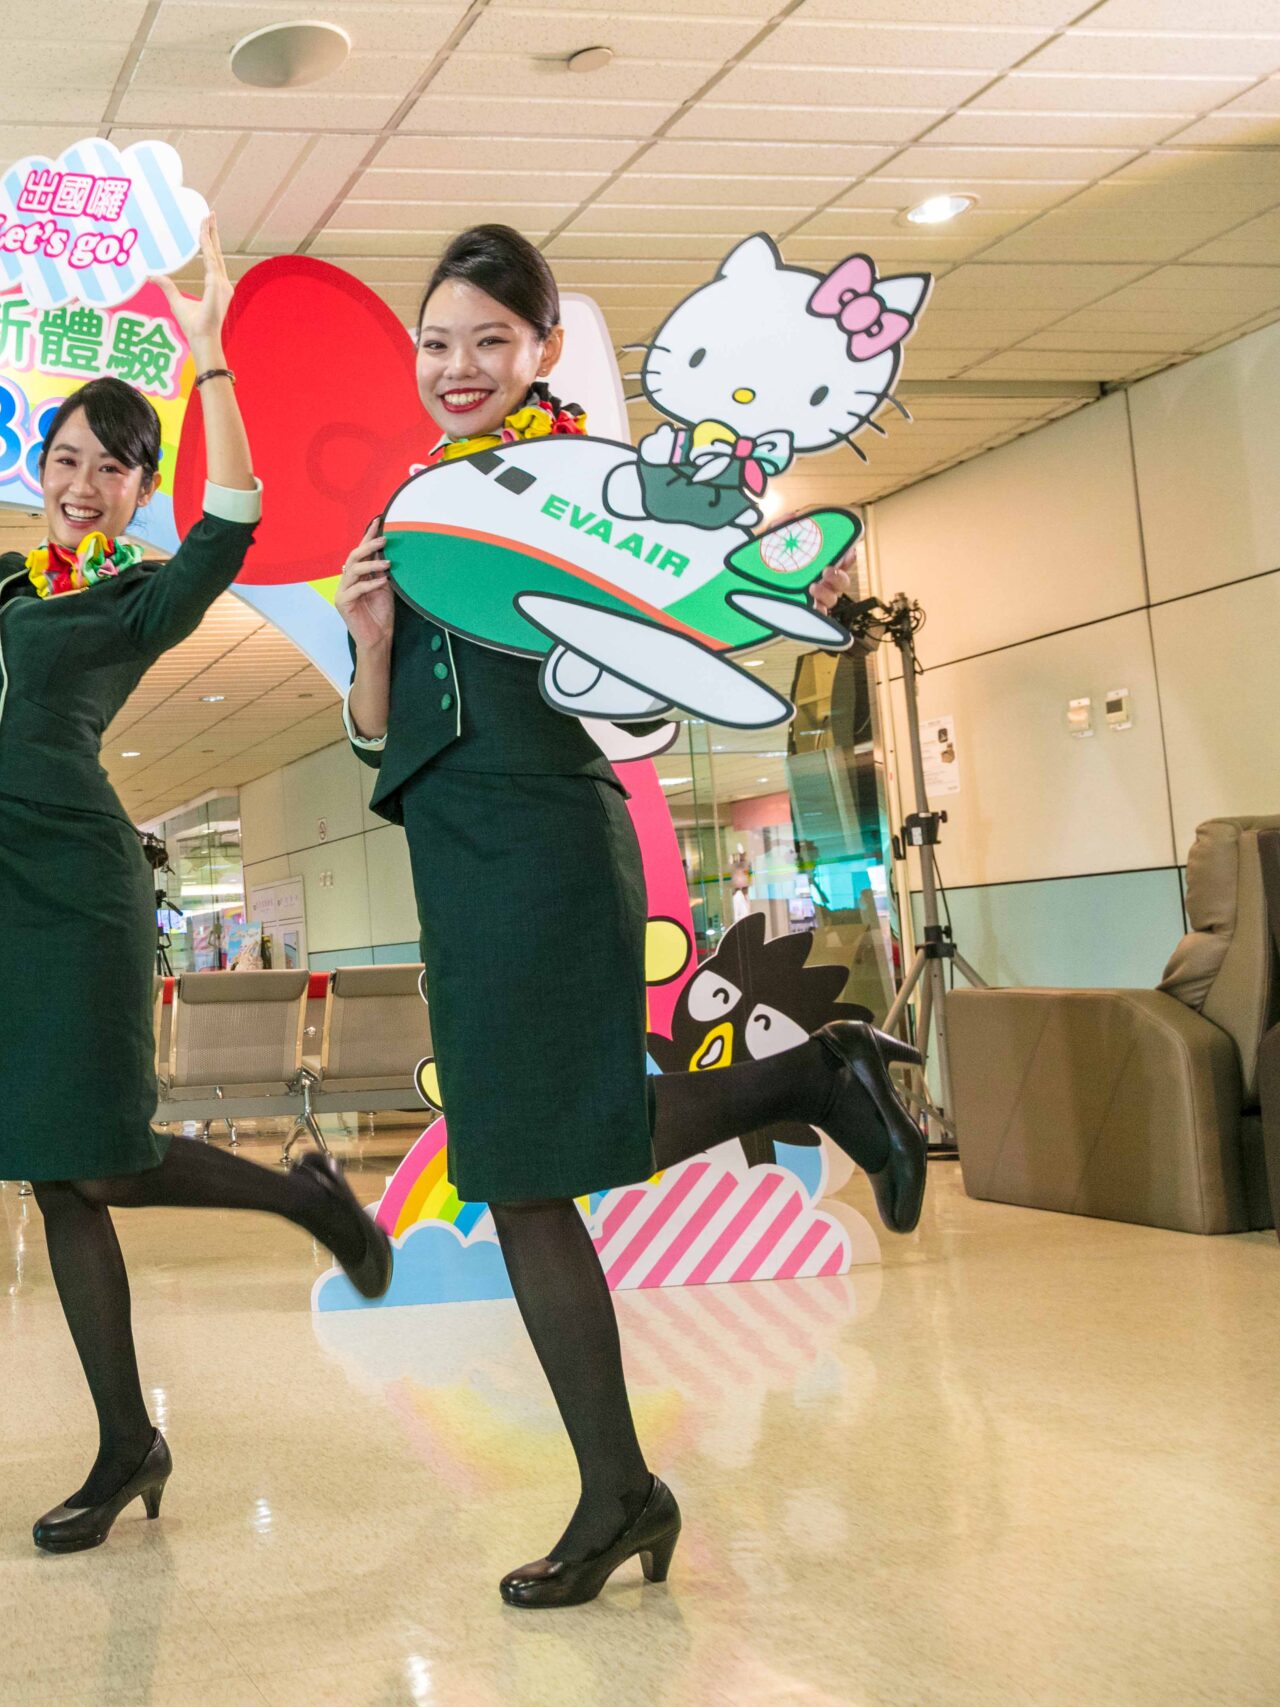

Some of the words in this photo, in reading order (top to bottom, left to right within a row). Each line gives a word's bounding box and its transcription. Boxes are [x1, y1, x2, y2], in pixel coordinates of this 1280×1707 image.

[18, 168, 131, 221] 出國囉
[68, 228, 138, 269] go!
[540, 493, 613, 544] EVA
[613, 532, 690, 578] AIR
